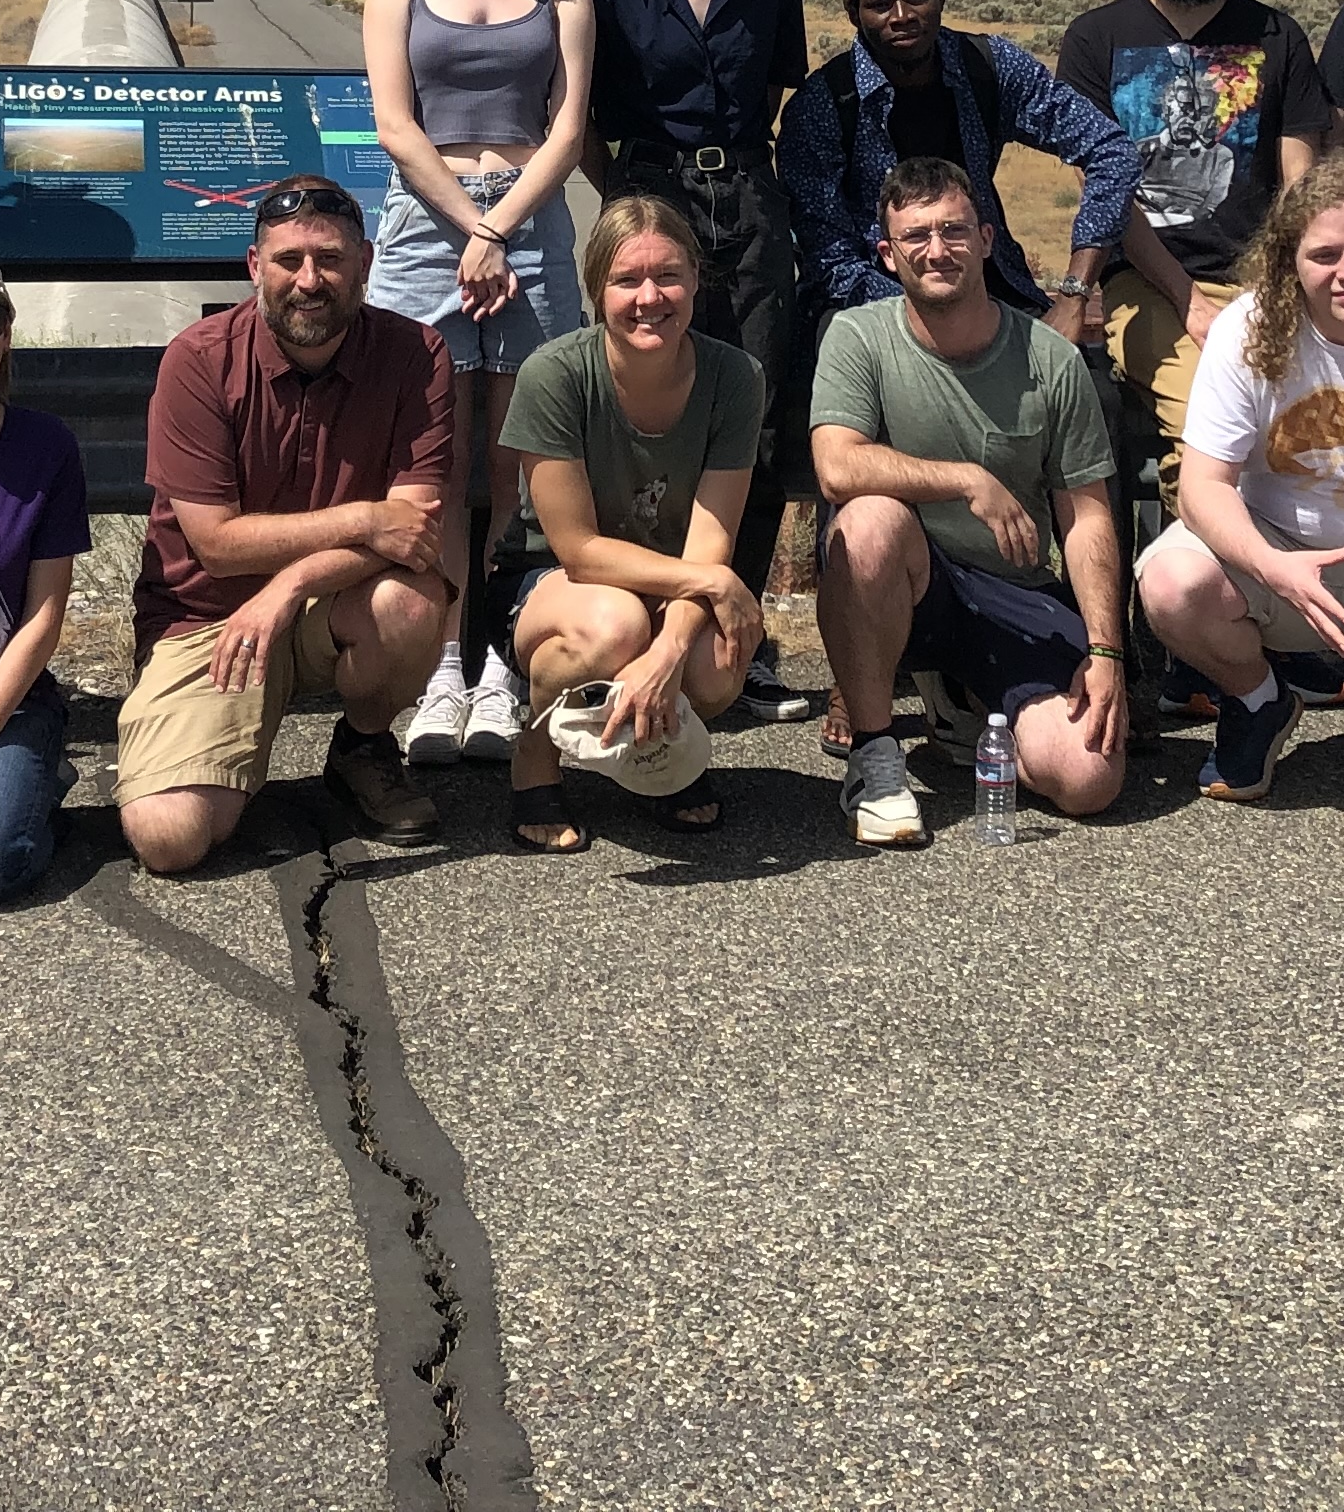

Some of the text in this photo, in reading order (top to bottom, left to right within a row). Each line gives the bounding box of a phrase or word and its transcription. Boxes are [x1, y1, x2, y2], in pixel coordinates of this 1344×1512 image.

[5, 83, 283, 103] LIGO's Detector Arms
[148, 104, 170, 113] with
[183, 105, 224, 113] massive
